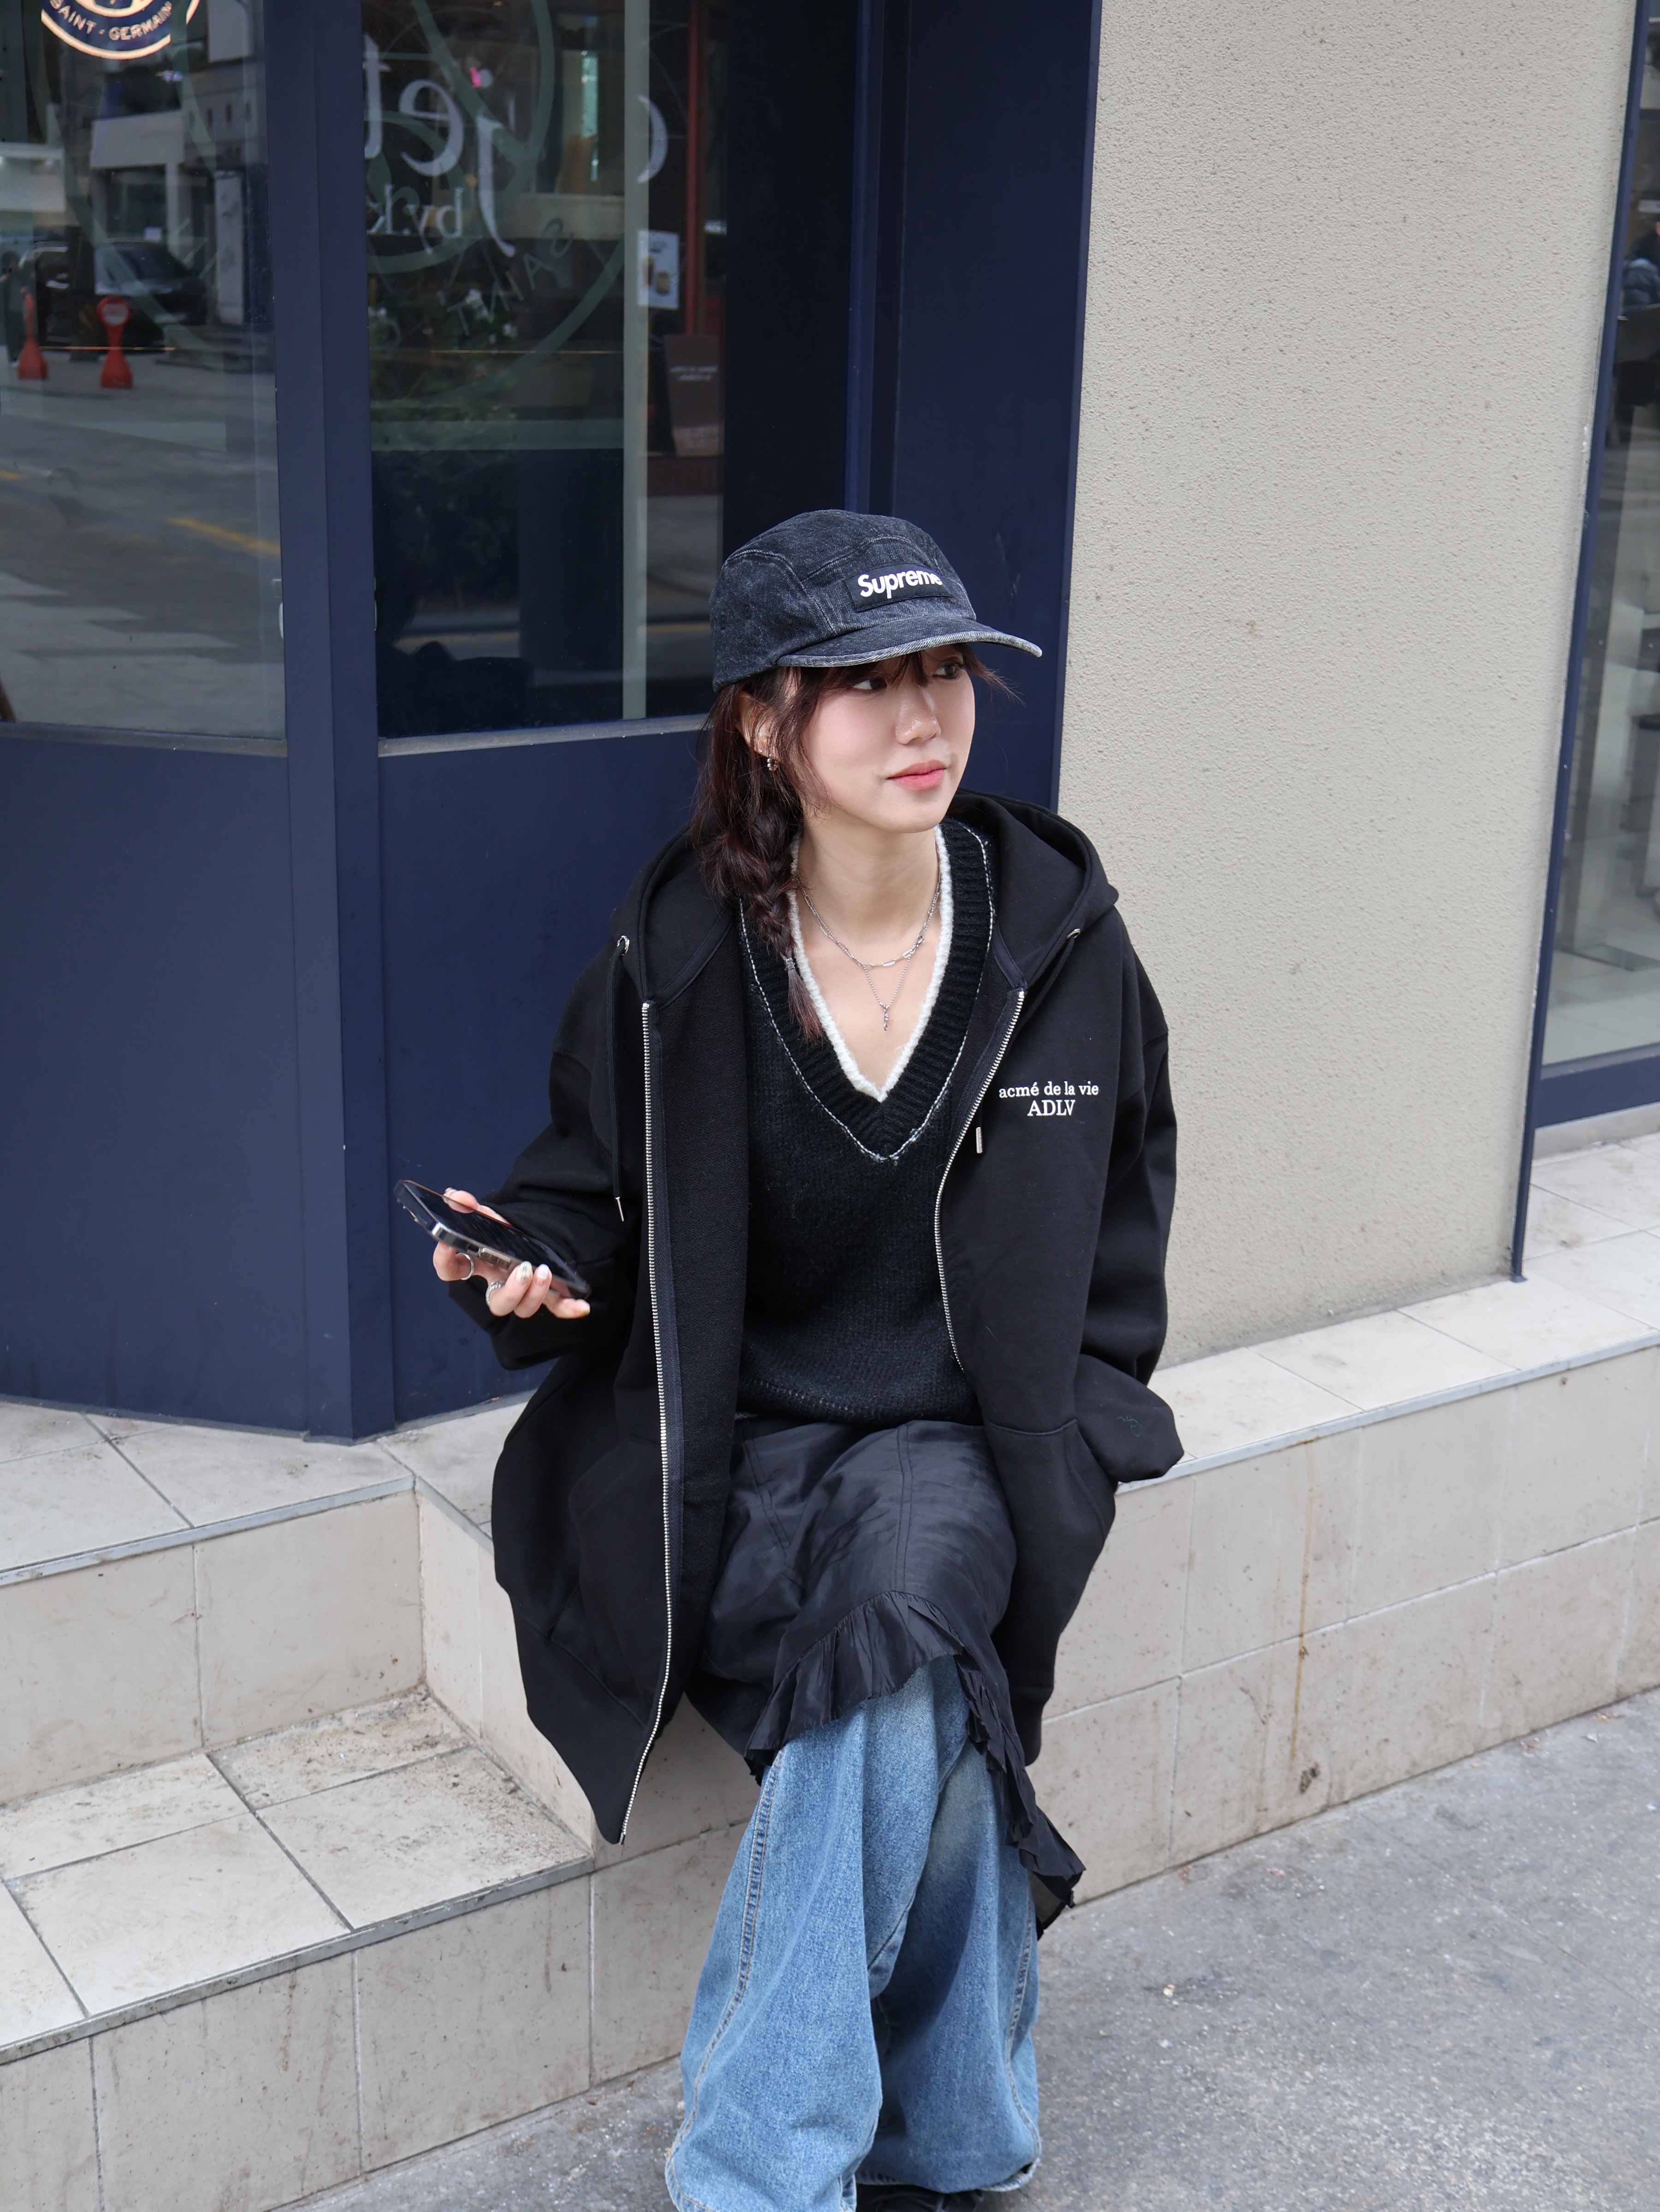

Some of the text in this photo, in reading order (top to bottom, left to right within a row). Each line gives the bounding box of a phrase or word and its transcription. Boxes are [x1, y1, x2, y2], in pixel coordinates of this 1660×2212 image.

[858, 570, 943, 599] Supreme
[998, 1081, 1099, 1098] acmé de la vie
[1027, 1099, 1075, 1116] ADLV
